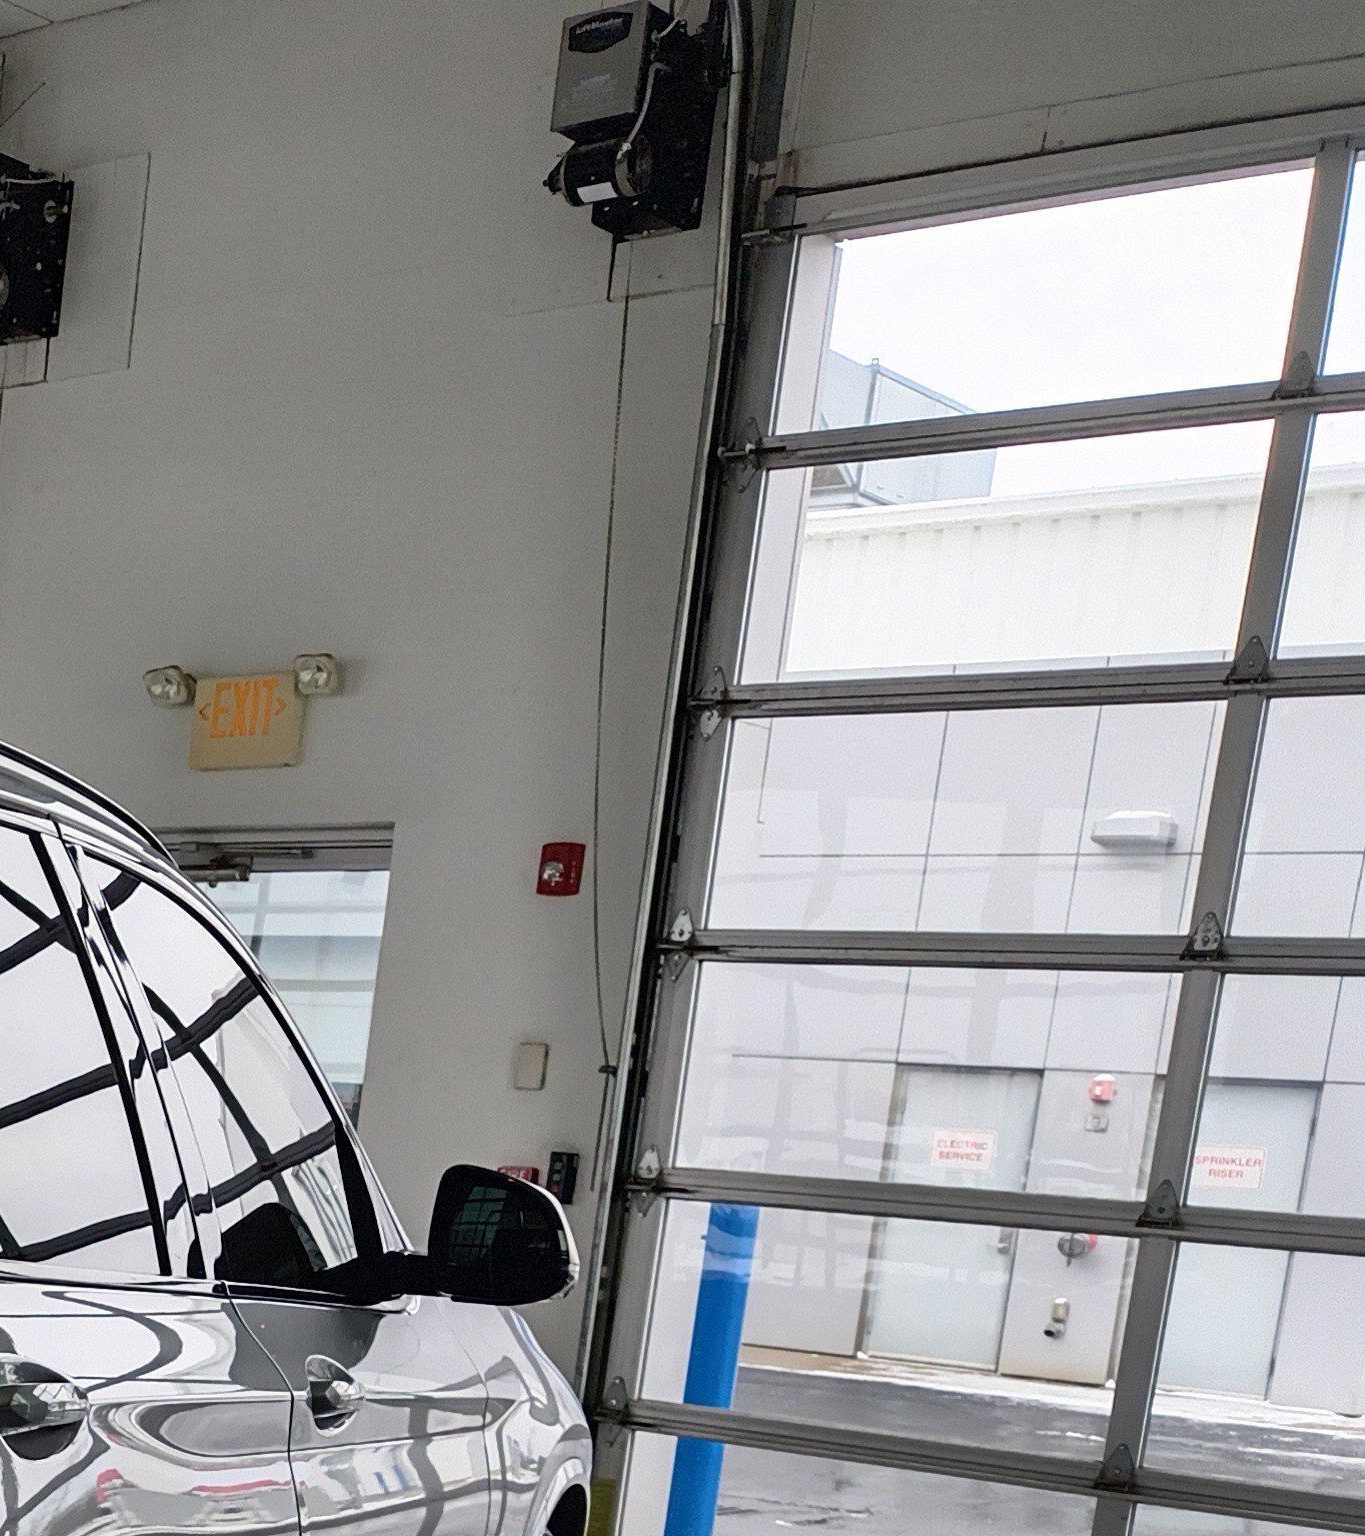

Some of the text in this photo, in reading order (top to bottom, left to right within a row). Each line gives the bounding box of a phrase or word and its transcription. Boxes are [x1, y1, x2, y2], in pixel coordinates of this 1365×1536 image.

[209, 677, 280, 739] EXIT
[937, 1139, 988, 1151] ELECTRIC
[939, 1150, 984, 1162] SERVICE
[1195, 1155, 1262, 1168] SPRINKLER
[1208, 1168, 1244, 1179] RISER
